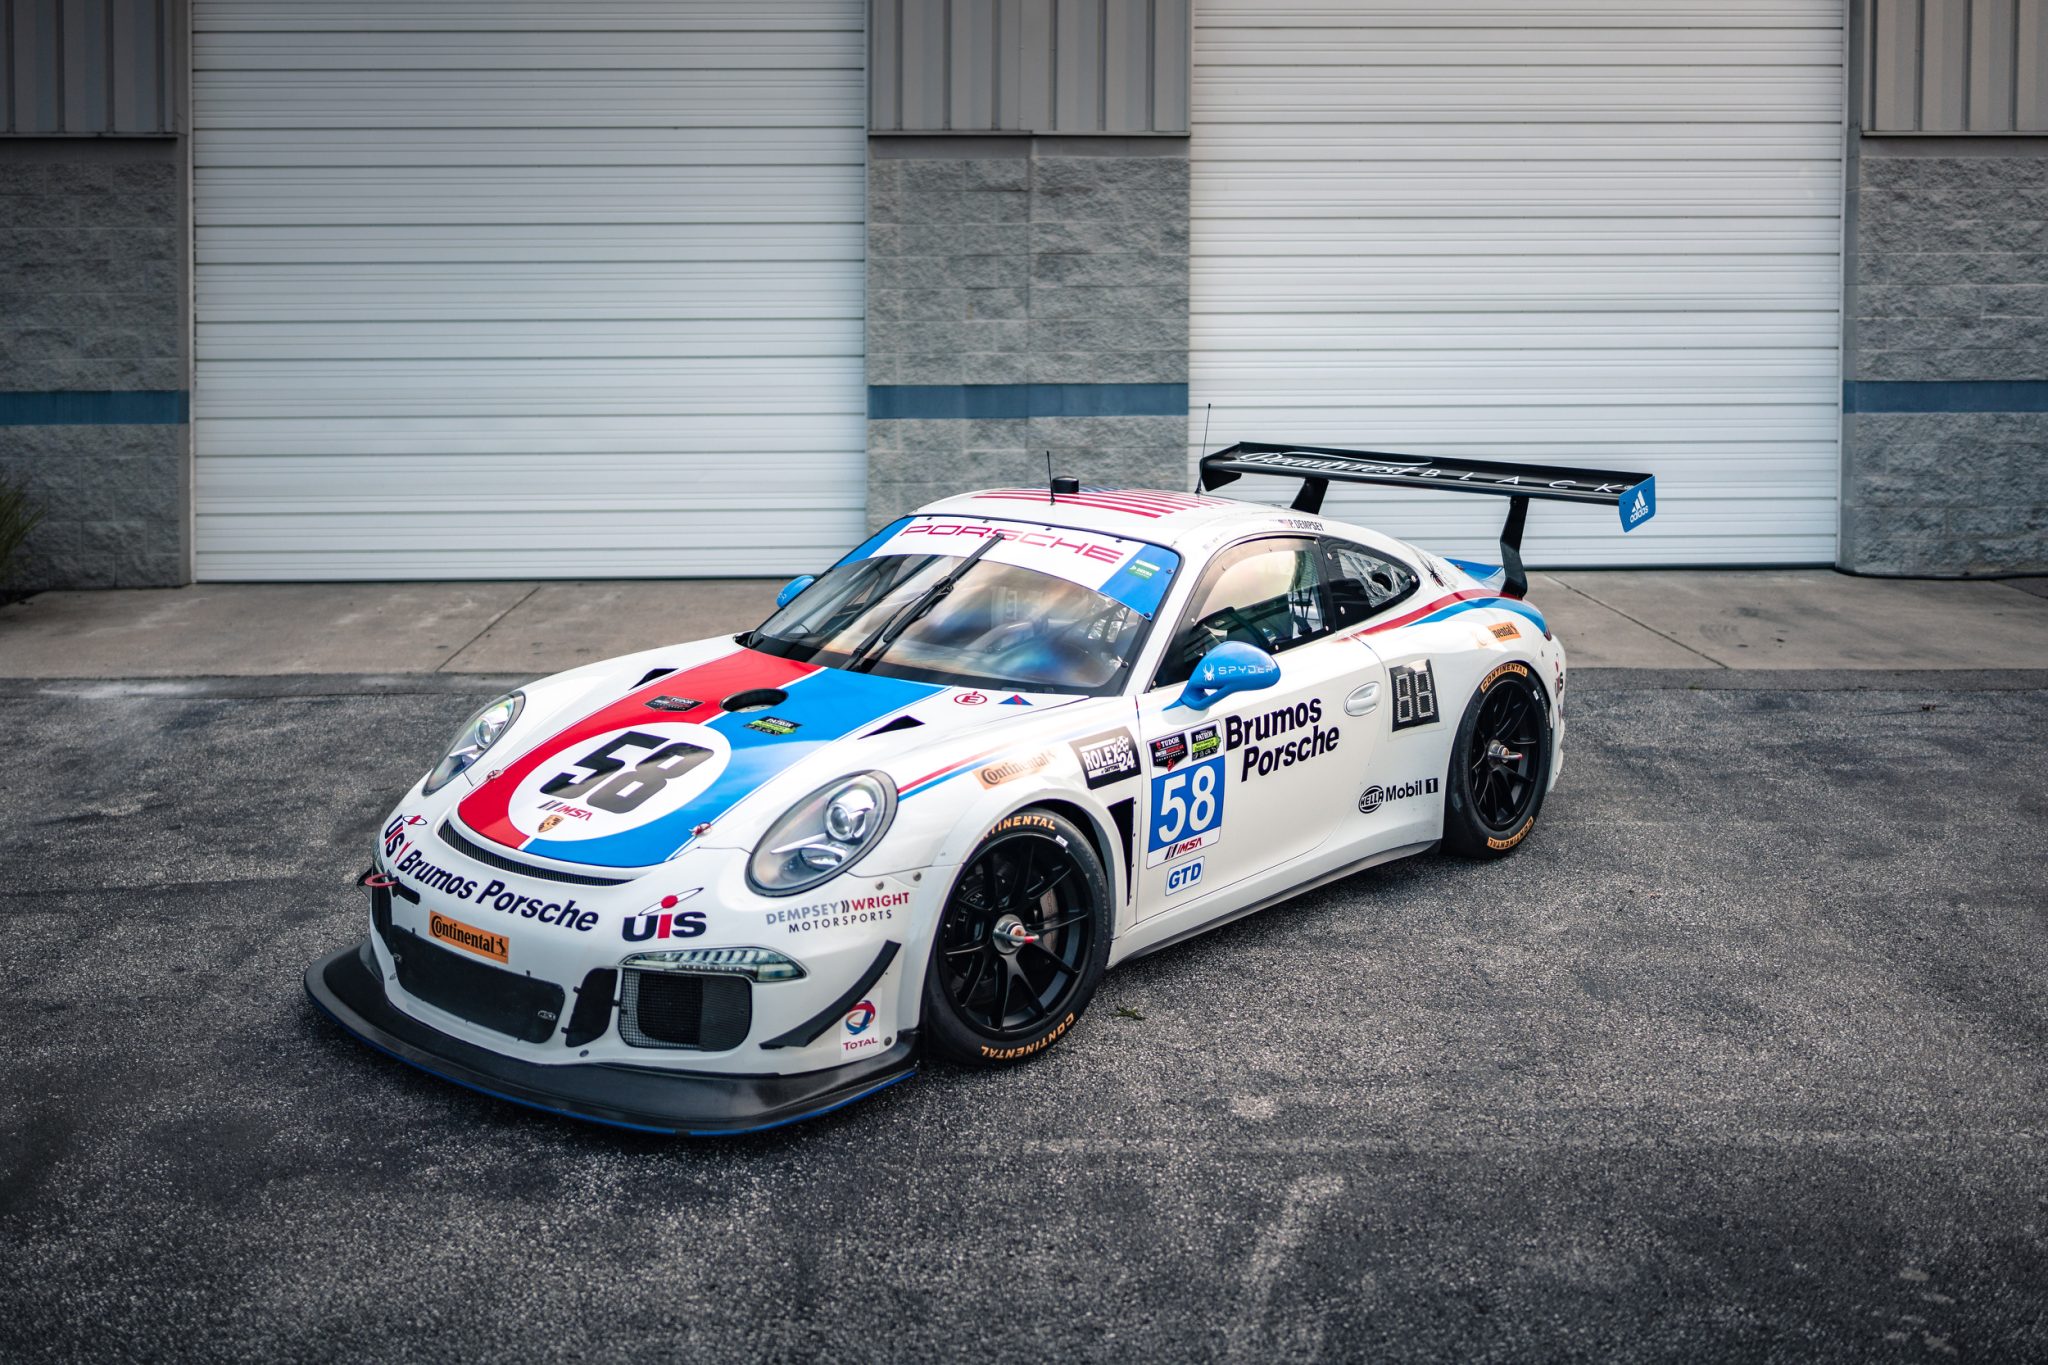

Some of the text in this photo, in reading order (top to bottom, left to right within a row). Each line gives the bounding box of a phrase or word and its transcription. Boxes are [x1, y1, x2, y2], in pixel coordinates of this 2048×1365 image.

[1295, 520, 1325, 532] DEMPSEY
[1629, 504, 1649, 524] adidas
[899, 525, 1124, 565] PORSCHE
[1218, 664, 1275, 675] SPYDER
[1482, 663, 1528, 690] CONTINENTAL
[1224, 697, 1322, 752] Brumos
[1160, 736, 1180, 748] TUDOR
[1240, 724, 1340, 783] Porsche
[981, 752, 1050, 786] Continental
[1081, 743, 1122, 772] ROLEX
[1118, 750, 1136, 772] 24
[539, 730, 715, 814] 58
[1157, 765, 1216, 843] 58
[1359, 790, 1384, 807] HELLA
[1385, 780, 1422, 802] Mobil
[554, 804, 594, 821] IMSA
[1177, 837, 1202, 855] IMSA
[1168, 862, 1202, 889] GTD
[397, 849, 599, 932] Brumos Porsche
[766, 892, 910, 925] DEMPSEY WRIGHT
[788, 909, 893, 934] MOTORSPORTS
[431, 915, 496, 954] Continental
[843, 1036, 879, 1051] TOTAL
[980, 1012, 1076, 1061] CONTINENTAL
